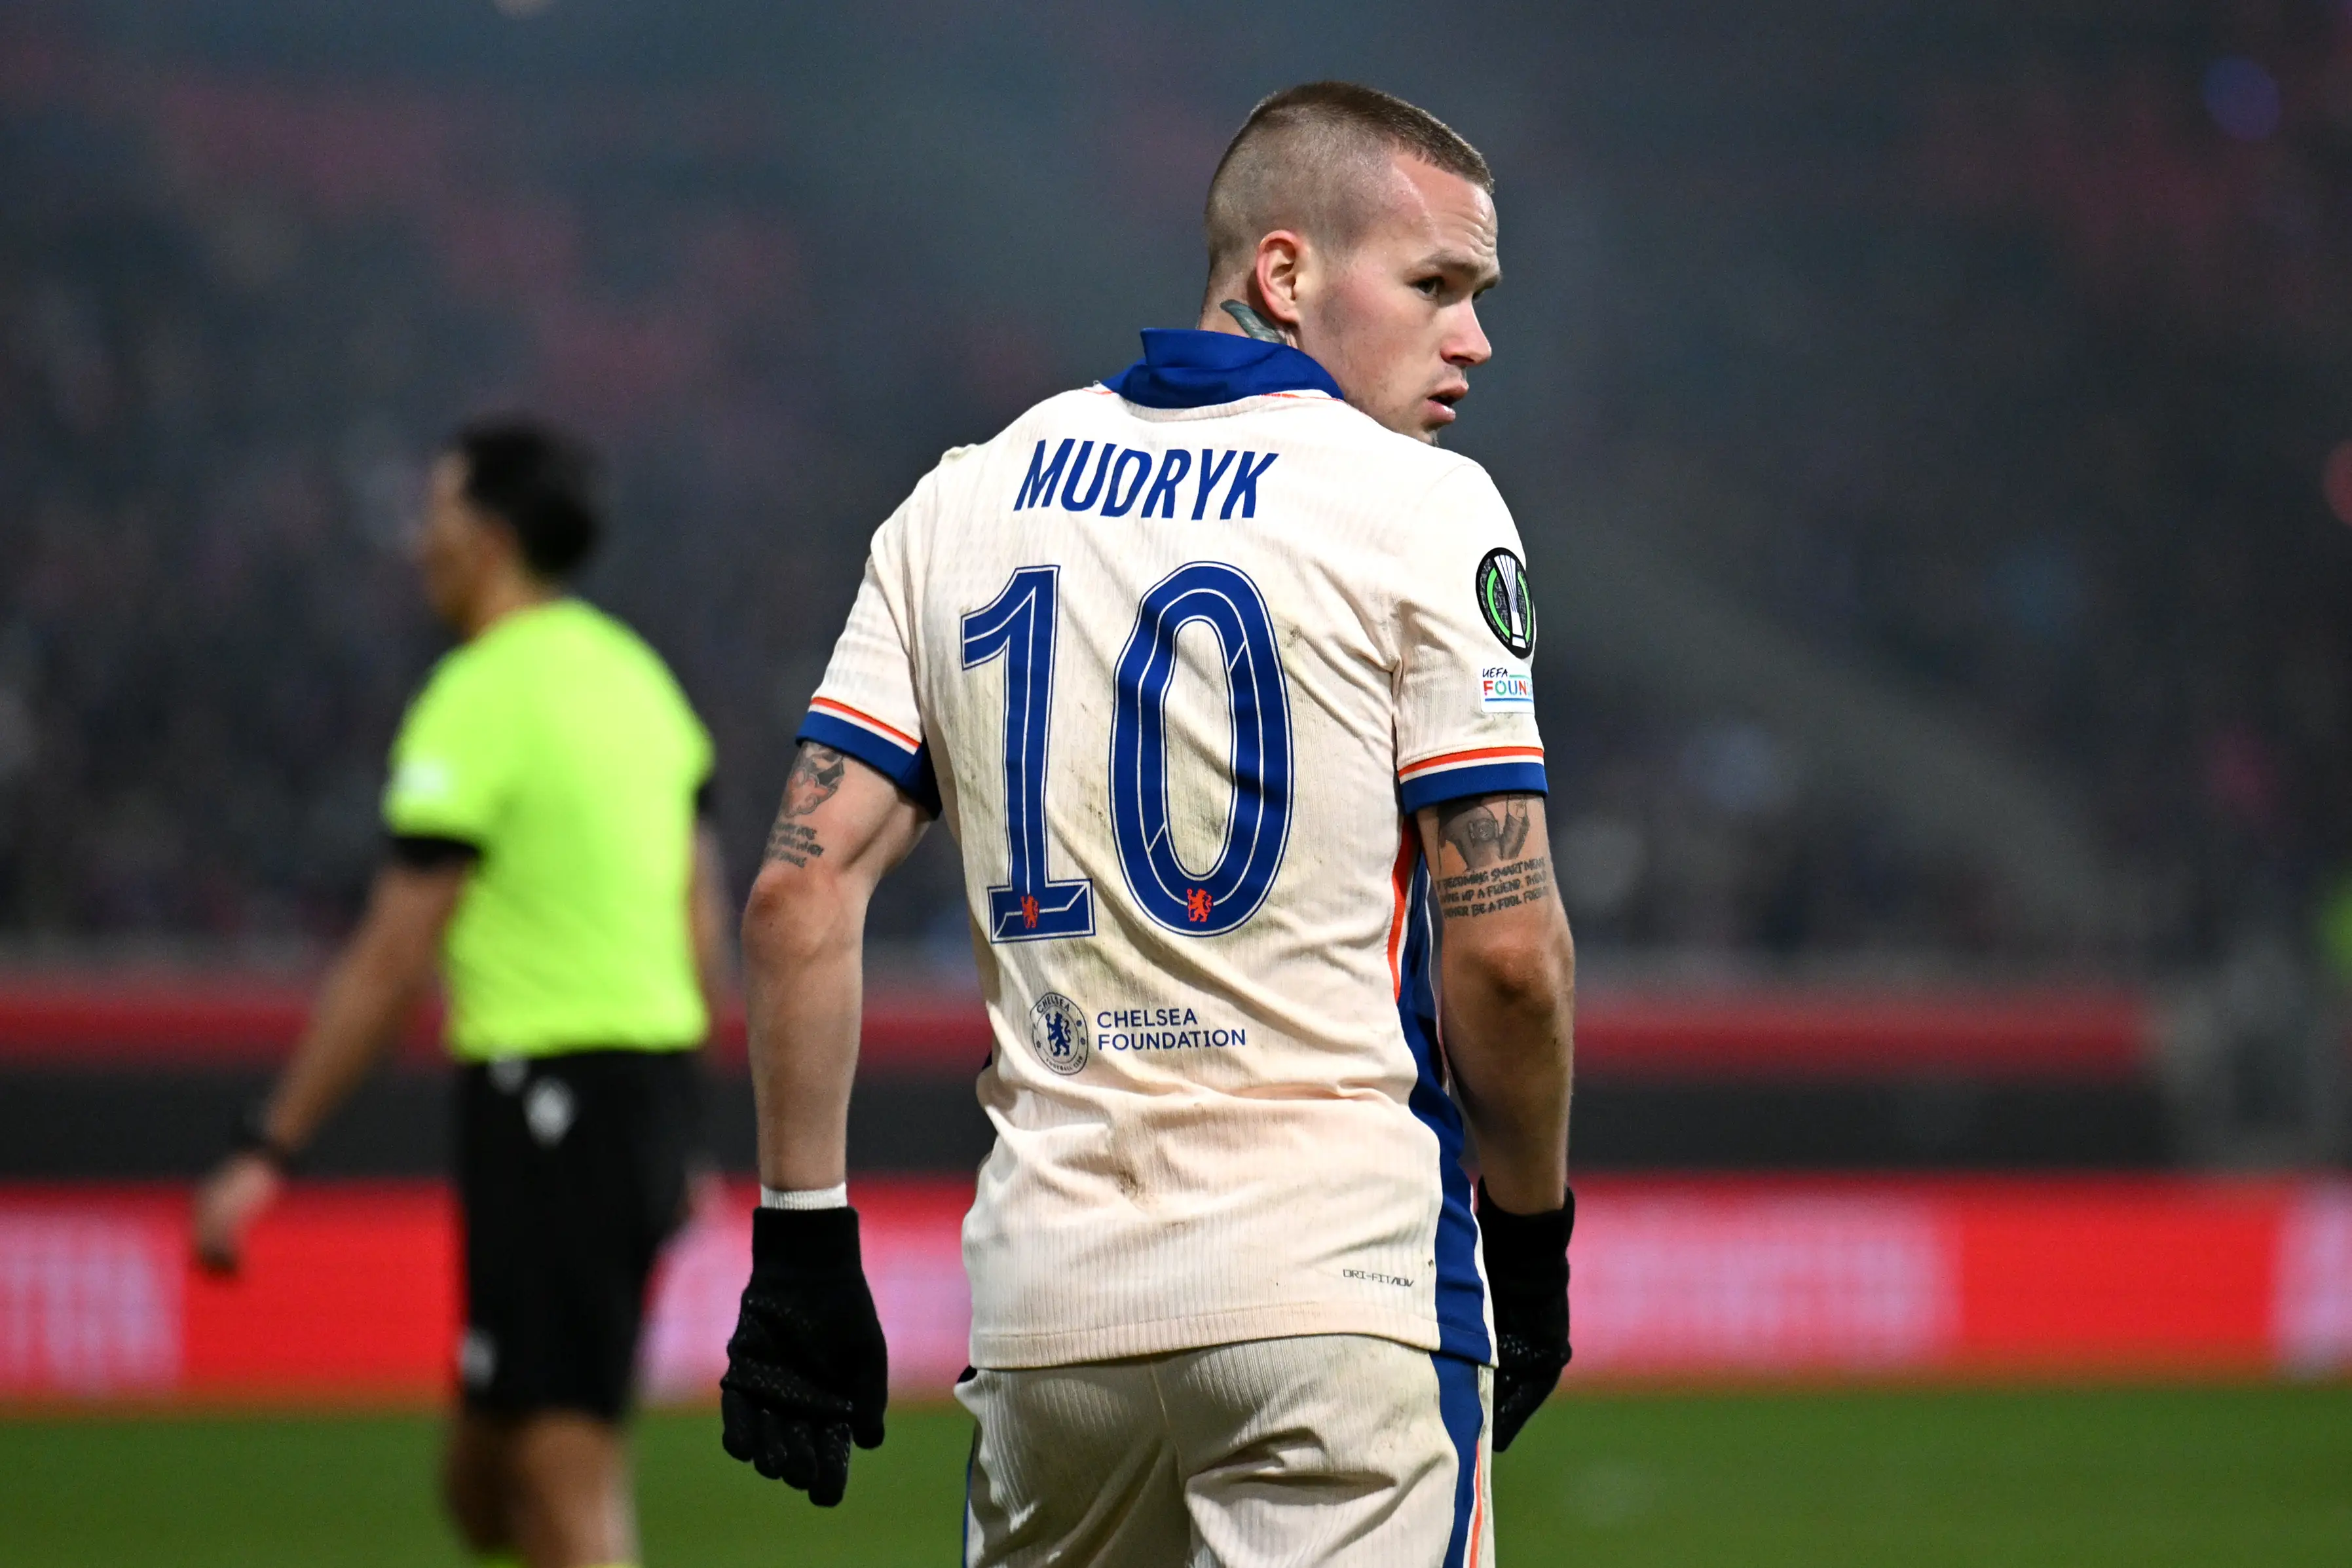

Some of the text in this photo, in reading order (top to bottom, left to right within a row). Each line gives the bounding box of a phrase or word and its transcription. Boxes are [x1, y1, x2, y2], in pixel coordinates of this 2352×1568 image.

[1013, 438, 1279, 521] MUDRYK
[1482, 667, 1508, 679] UEFA
[961, 561, 1294, 944] 10
[1037, 996, 1070, 1013] CHELSEA
[1096, 1008, 1199, 1028] CHELSEA
[1098, 1029, 1247, 1051] FOUNDATION
